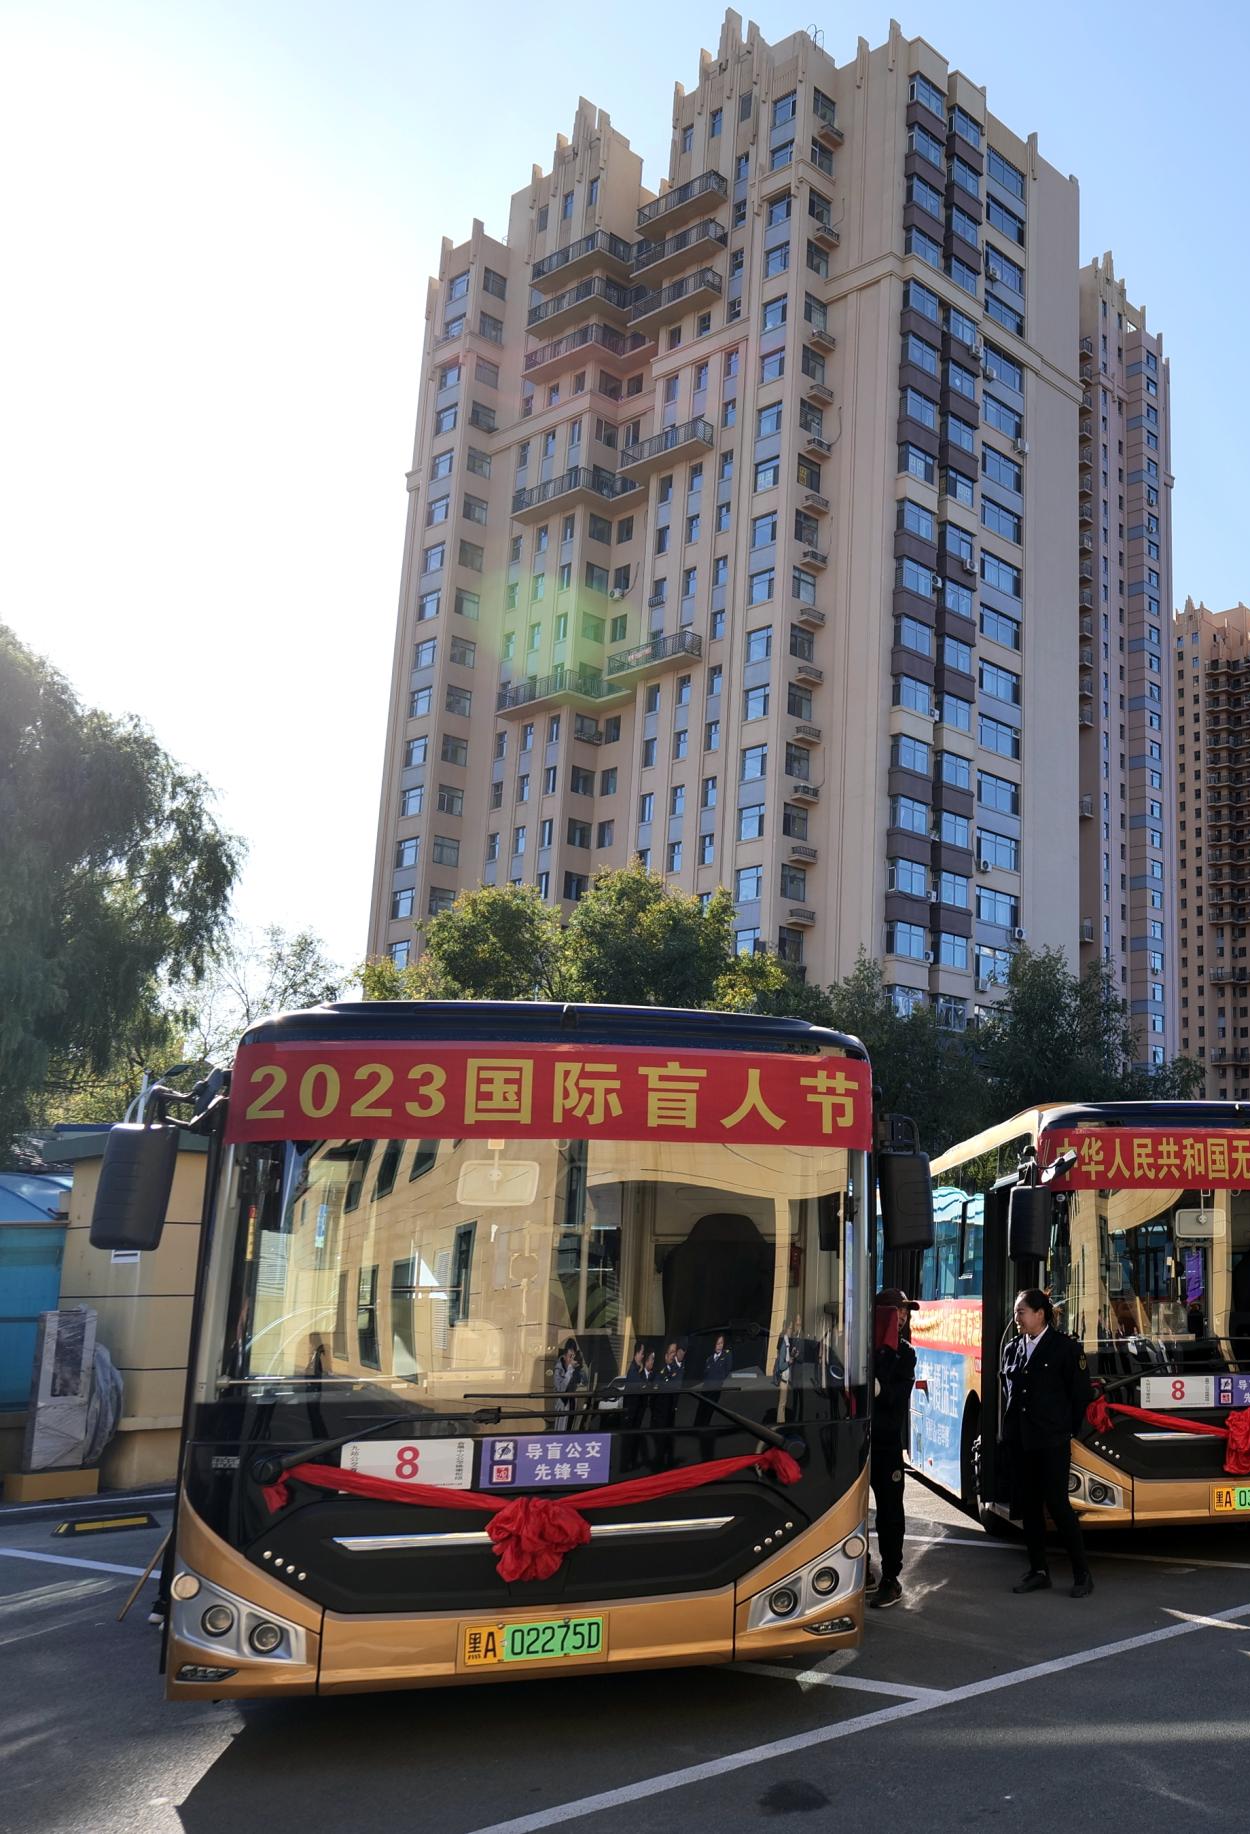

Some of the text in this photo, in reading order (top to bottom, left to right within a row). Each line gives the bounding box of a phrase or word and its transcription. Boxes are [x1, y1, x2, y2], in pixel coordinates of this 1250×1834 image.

[246, 1058, 859, 1134] 2023国际盲人节
[1171, 1379, 1185, 1401] 8
[525, 1441, 602, 1460] 导盲公交
[395, 1446, 420, 1479] 8
[534, 1462, 591, 1481] 先锋号
